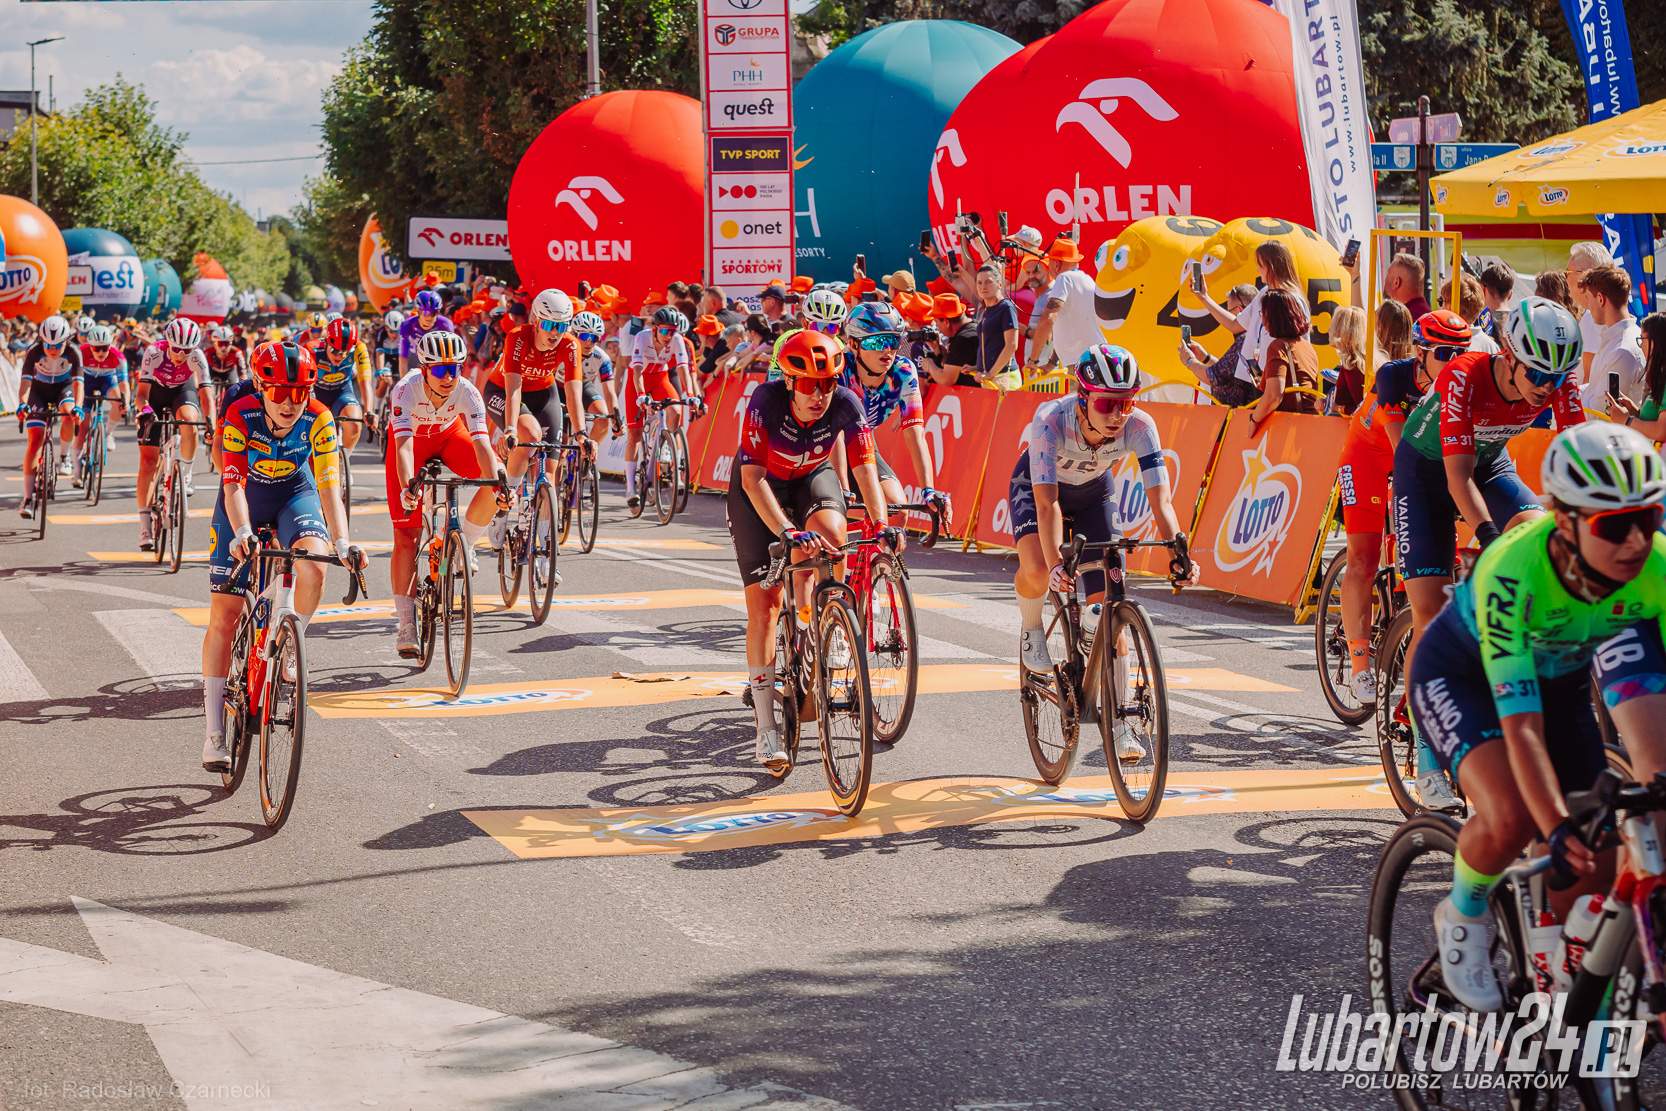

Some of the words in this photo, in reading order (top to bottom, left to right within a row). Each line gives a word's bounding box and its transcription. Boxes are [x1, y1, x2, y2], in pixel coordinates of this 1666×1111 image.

[738, 27, 780, 37] GRUPA
[732, 70, 763, 81] PHH
[724, 98, 774, 120] quest
[1330, 16, 1356, 173] www.lubartow.pl
[720, 150, 743, 160] TVP
[745, 149, 781, 160] SPORT
[1045, 185, 1192, 225] ORLEN
[450, 231, 508, 247] ORLEN
[743, 221, 782, 235] onet
[547, 239, 632, 262] ORLEN
[721, 264, 783, 274] SPORTOWY
[1307, 278, 1342, 346] 5
[1447, 369, 1468, 423] VIFRA
[1342, 464, 1357, 506] FASSA
[1233, 490, 1285, 545] LOTTO
[1398, 495, 1411, 554] VAIANO
[1487, 575, 1520, 661] VIFRA
